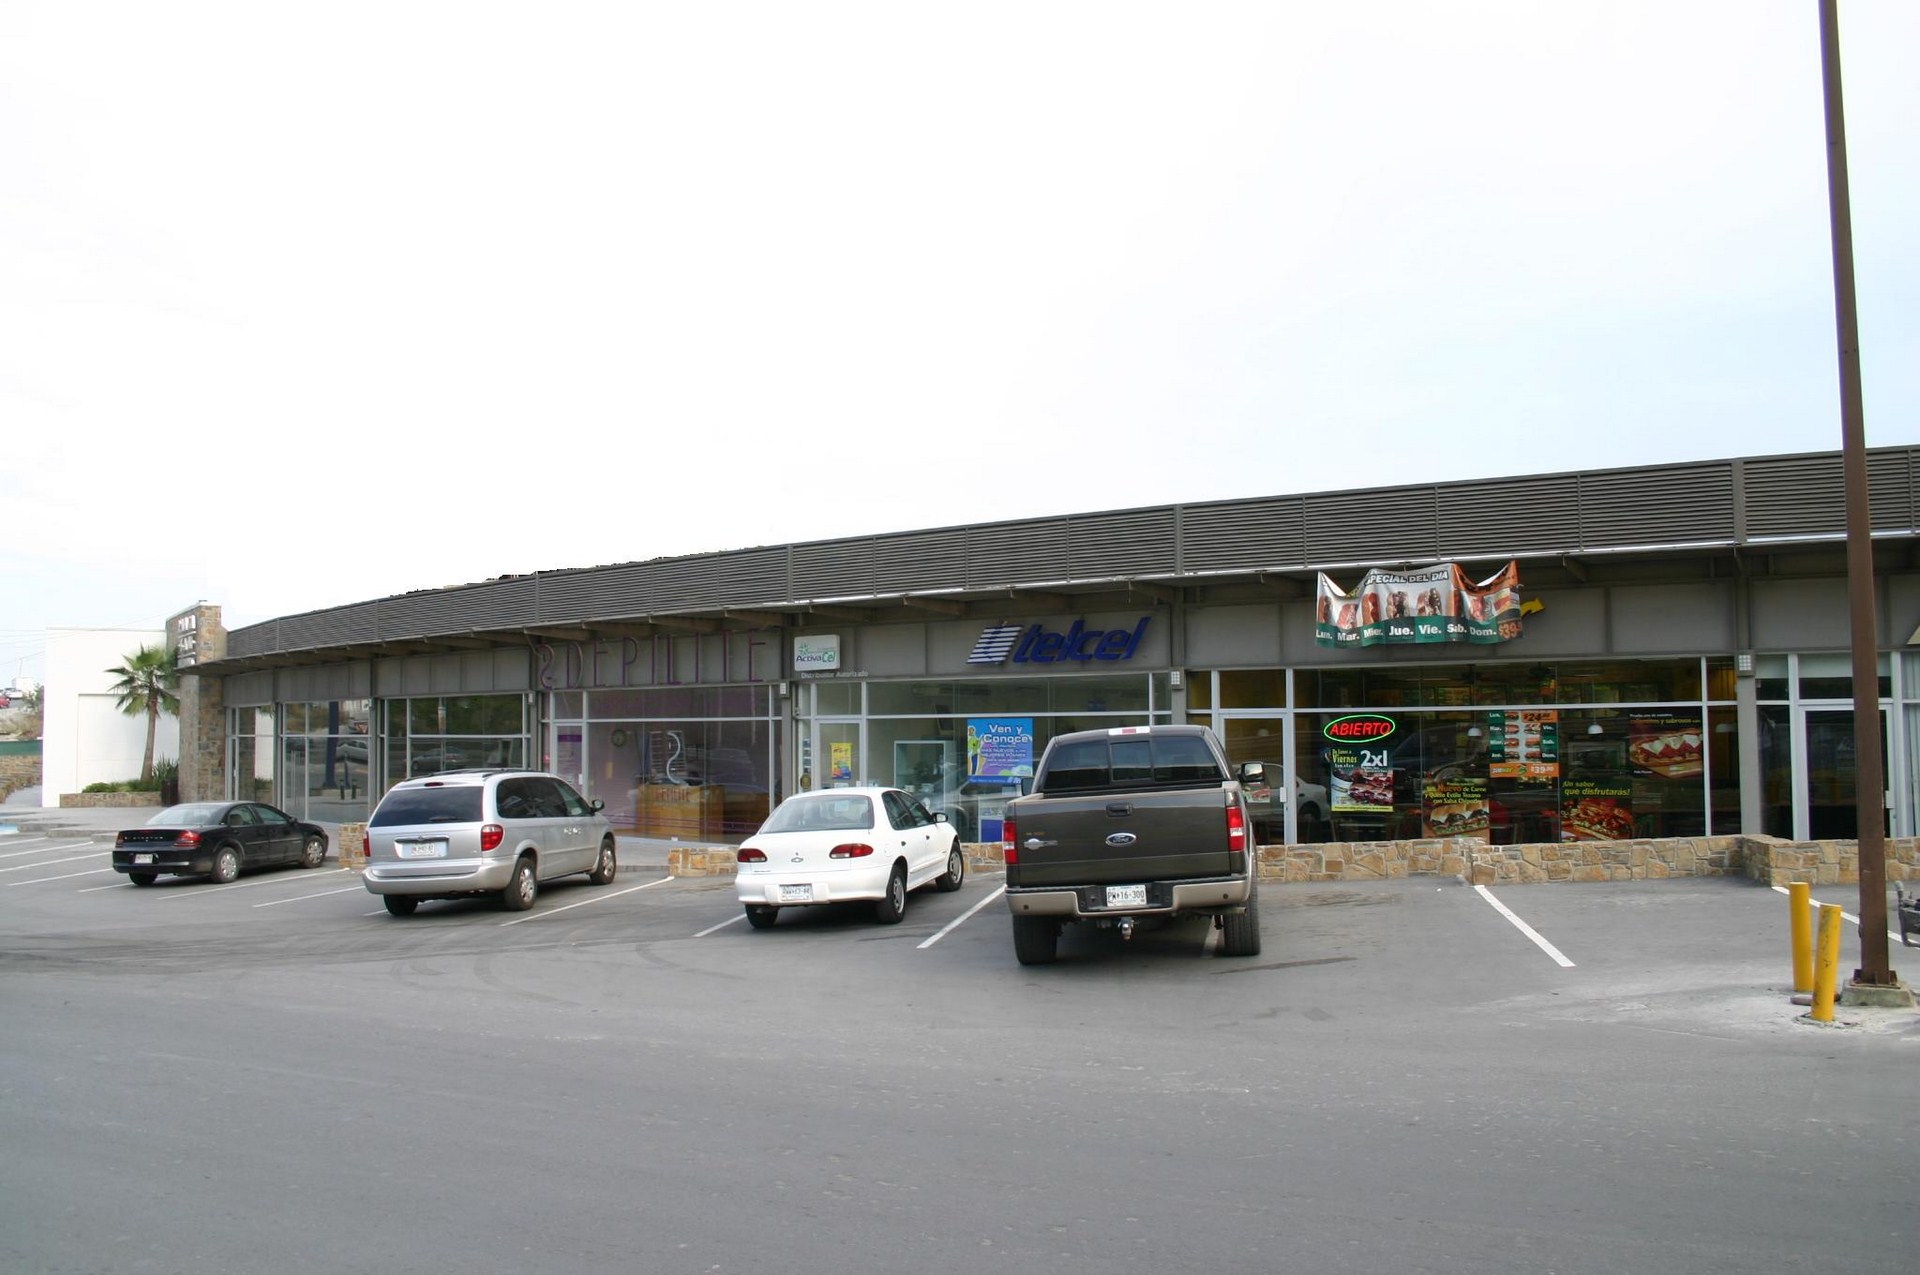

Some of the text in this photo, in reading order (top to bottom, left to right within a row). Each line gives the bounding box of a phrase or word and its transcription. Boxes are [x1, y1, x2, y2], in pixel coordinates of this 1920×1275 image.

[1408, 574, 1429, 583] DEL
[1337, 632, 1360, 642] Mar.
[1388, 625, 1414, 636] Jue.
[1418, 624, 1442, 635] Vie.
[1469, 626, 1497, 636] Dom.
[1012, 616, 1152, 663] telcel
[988, 724, 1023, 735] Ven y
[1329, 722, 1392, 736] ABIERTO
[983, 734, 1028, 743] Conoce
[1332, 754, 1357, 763] Viernes
[1564, 788, 1580, 796] que
[1112, 835, 1130, 843] Ford
